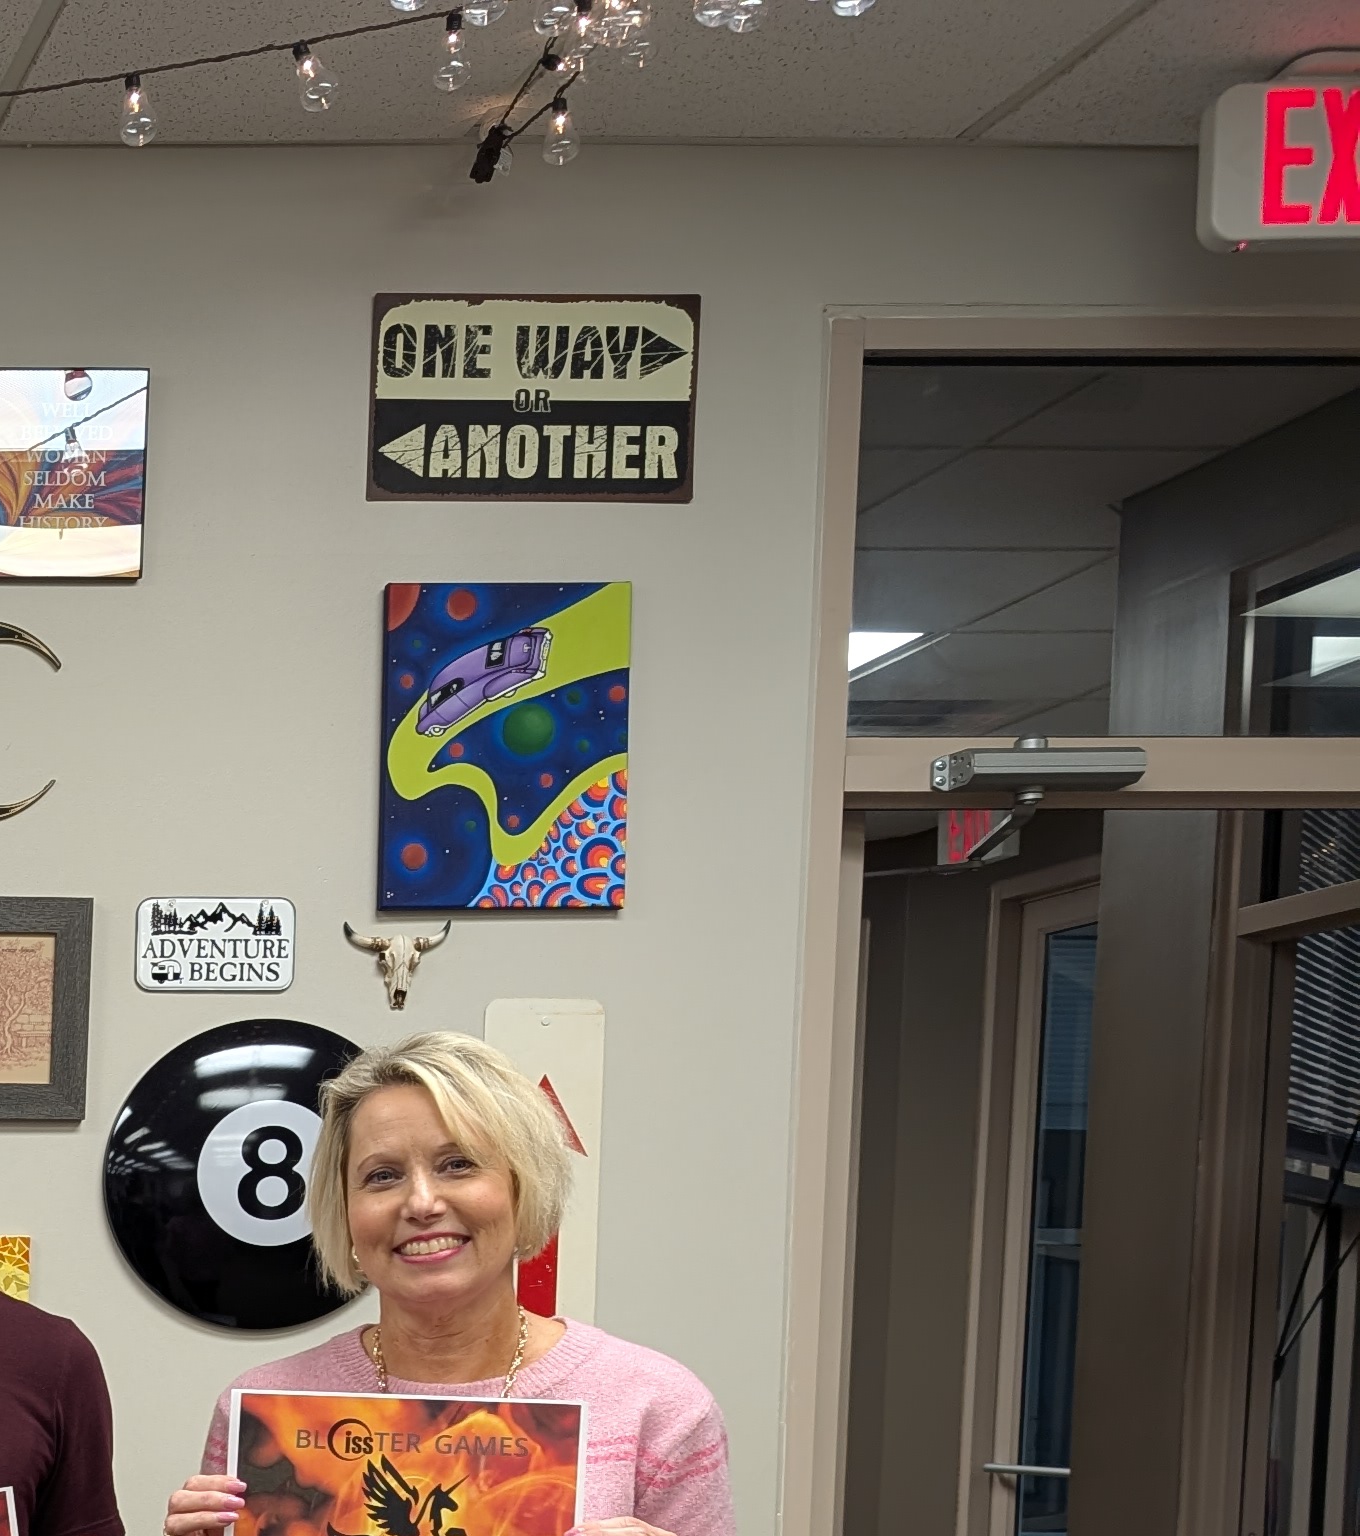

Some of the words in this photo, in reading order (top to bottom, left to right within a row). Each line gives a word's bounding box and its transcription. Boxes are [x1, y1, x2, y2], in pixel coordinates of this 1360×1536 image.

[383, 323, 494, 379] ONE
[515, 325, 640, 380] WAY
[513, 387, 552, 413] OR
[429, 424, 679, 480] ANOTHER
[24, 471, 107, 487] SELDOM
[33, 493, 95, 509] MAKE
[141, 939, 290, 959] ADVENTURE
[189, 962, 280, 982] BEGINS
[237, 1125, 306, 1221] 8
[435, 1434, 529, 1458] GAMES
